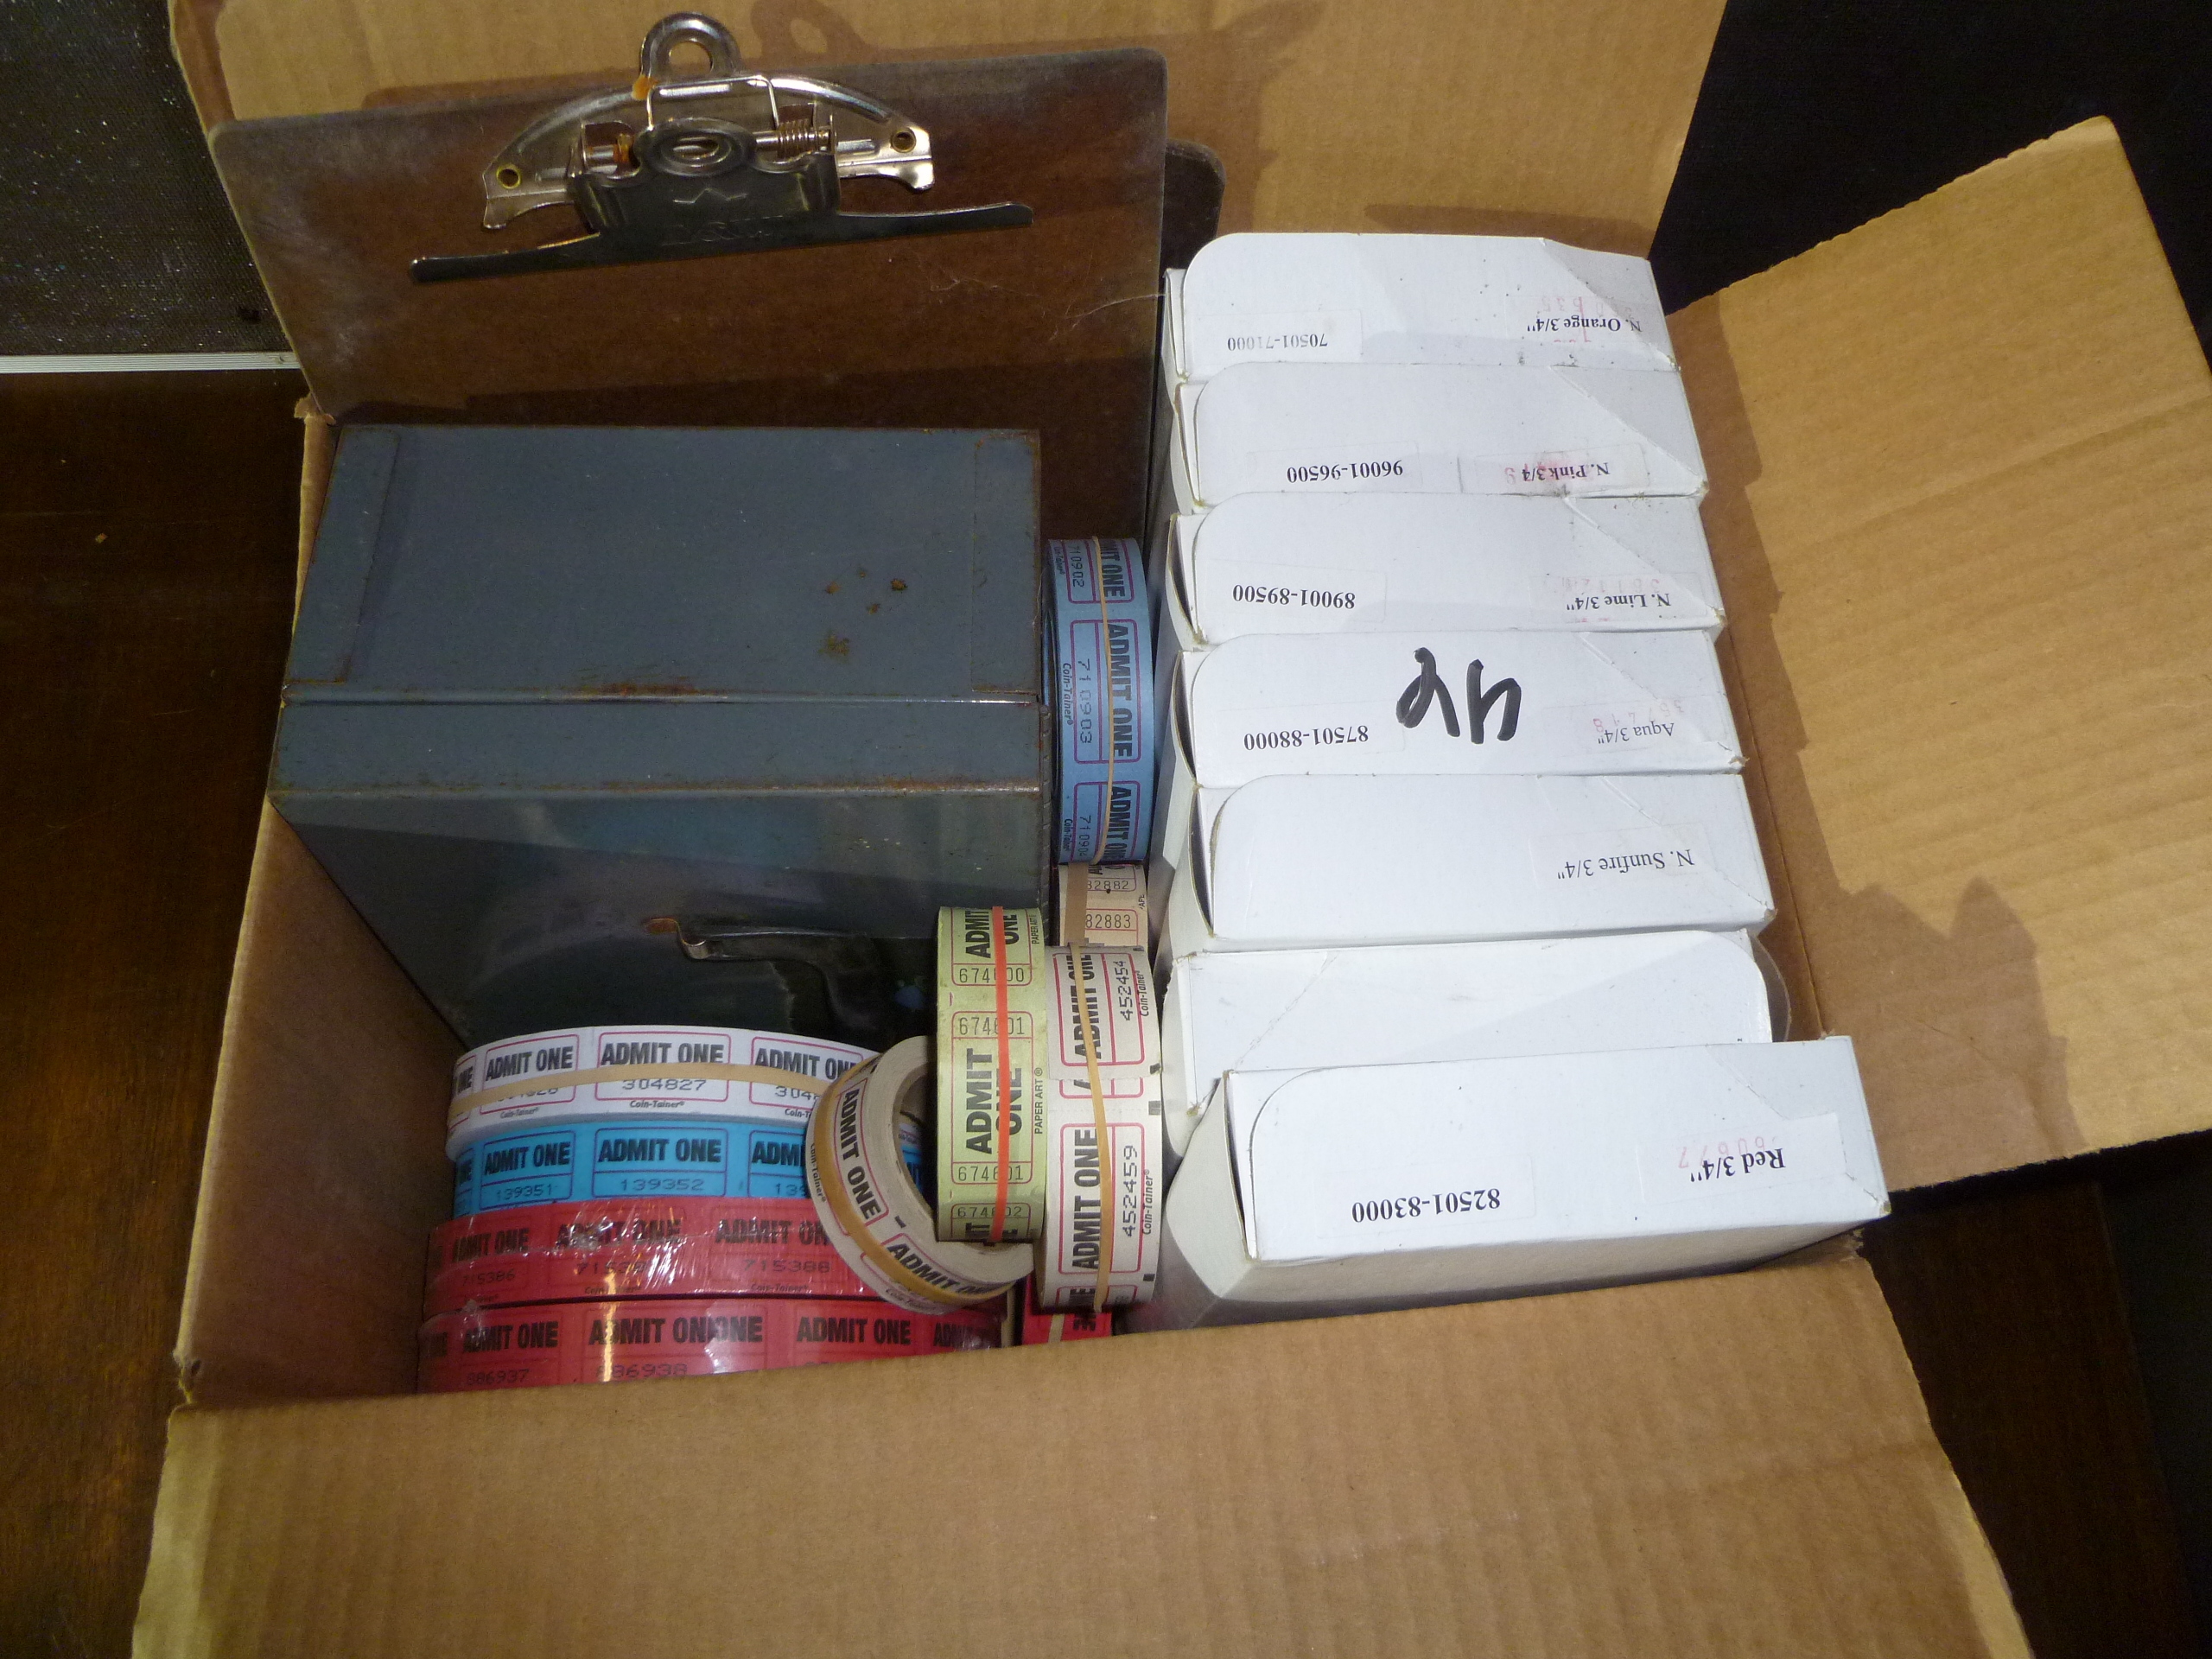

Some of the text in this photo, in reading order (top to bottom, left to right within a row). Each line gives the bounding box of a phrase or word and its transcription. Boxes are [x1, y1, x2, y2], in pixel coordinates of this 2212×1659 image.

[1527, 315, 1643, 333] N. Orange 3/4"
[1227, 333, 1328, 352] 70501-71000
[1287, 460, 1404, 483] 96001-96500
[1550, 464, 1588, 480] Pink
[1591, 461, 1611, 476] N.
[1101, 566, 1126, 598] ONE
[1232, 584, 1356, 610] 89001-89500
[1566, 593, 1672, 611] N. Lime 3/4"
[1077, 658, 1093, 744] 710903
[1107, 623, 1133, 758] ADMIT ONE
[1243, 725, 1369, 751] 87501-88000
[1598, 721, 1675, 744] Aqua 3/4"
[1106, 785, 1132, 841] ADMIT
[1557, 849, 1695, 880] N. Sunfire 3/4"
[964, 910, 991, 959] ADMIT
[958, 966, 1025, 984] 67400
[1065, 953, 1096, 983] ONE
[1112, 960, 1135, 1021] 452454
[958, 1016, 1026, 1036] 67401
[1070, 985, 1103, 1060] ADMIT
[486, 1046, 574, 1082] ADMIT ONE
[601, 1041, 725, 1066] ADMIT ONE
[754, 1047, 821, 1077] ADMIT
[622, 1078, 707, 1091] 304827
[965, 1047, 993, 1155] ADMIT
[1034, 1098, 1043, 1135] PAPER
[484, 1146, 530, 1176] ADMIT
[532, 1141, 571, 1167] ONE
[598, 1138, 722, 1163] ADMIT ONE
[839, 1087, 882, 1220] ADMIT ONE
[1073, 1128, 1102, 1188] ONE
[1690, 1147, 1786, 1183] Red 3/4"
[620, 1178, 705, 1192] 139352
[957, 1165, 1024, 1183] 67401
[496, 1183, 553, 1201] 139351
[1122, 1144, 1138, 1237] 452459
[1351, 1188, 1501, 1223] 82501-83000
[957, 1206, 1023, 1218] 67402
[494, 1228, 530, 1252] ONE
[715, 1218, 831, 1245] ADMIT ON
[1071, 1195, 1102, 1271] ADMIT
[887, 1241, 961, 1294] ADMIT
[462, 1325, 514, 1354] ADMIT
[518, 1320, 559, 1349] ONE
[588, 1317, 666, 1346] ADMIT
[796, 1315, 912, 1345] ADMIT ONE
